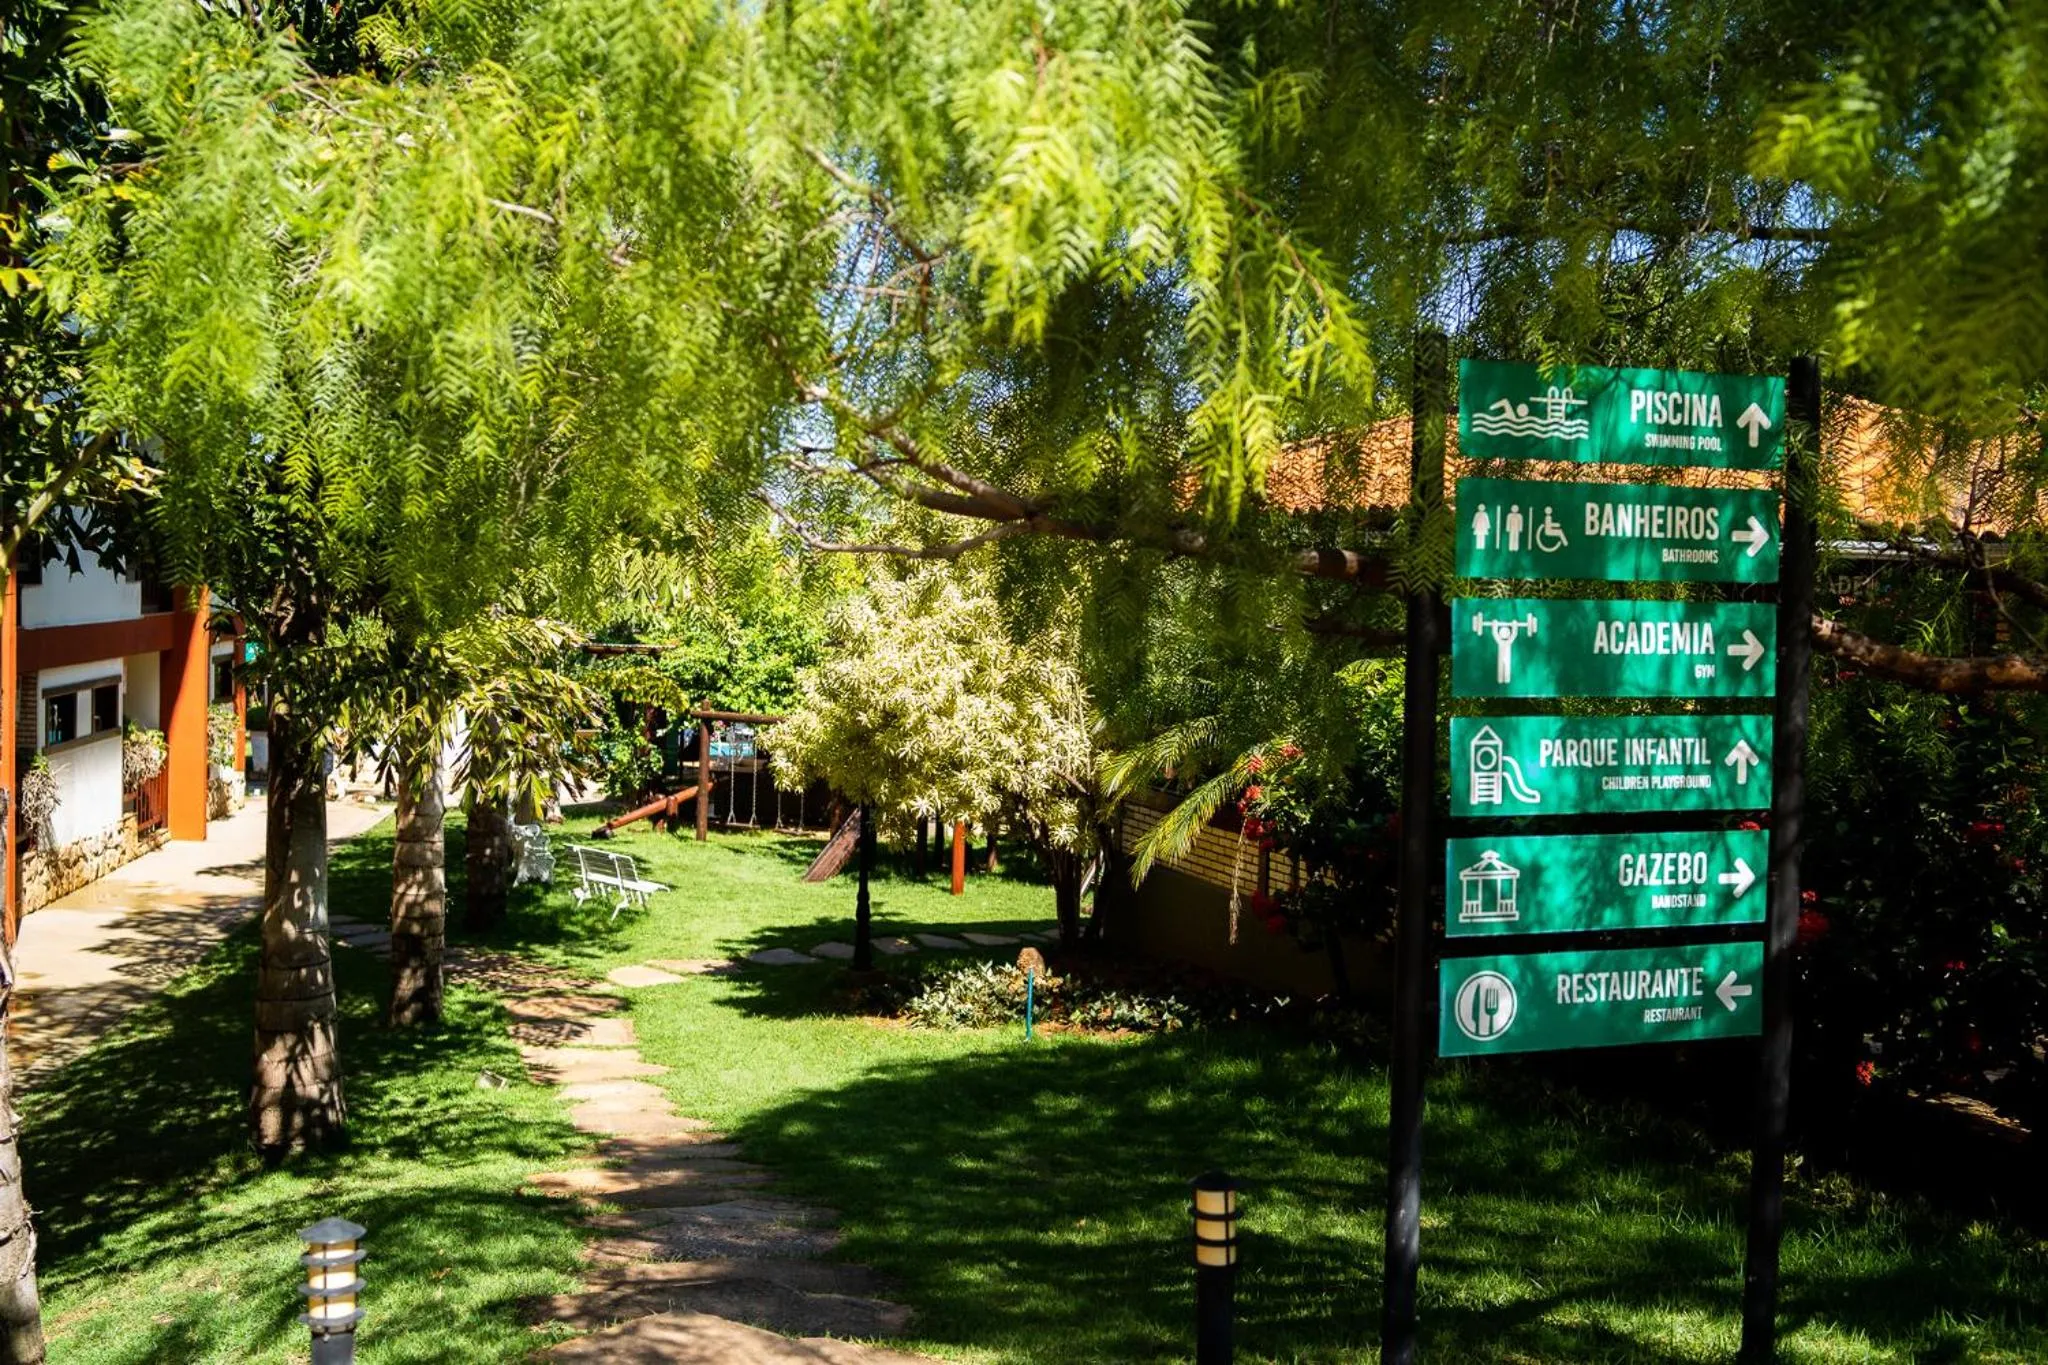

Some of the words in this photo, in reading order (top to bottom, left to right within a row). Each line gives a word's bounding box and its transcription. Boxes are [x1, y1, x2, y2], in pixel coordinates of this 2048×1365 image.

[1630, 389, 1723, 428] PISCINA
[1645, 433, 1695, 450] SWIMMING
[1697, 436, 1722, 451] POOL
[1585, 503, 1719, 541] BANHEIROS
[1662, 548, 1719, 564] BATHROOMS
[1594, 621, 1716, 656] ACADEMIA
[1695, 664, 1716, 679] GYM
[1539, 739, 1619, 768] PARQUE
[1624, 738, 1712, 768] INFANTIL
[1602, 776, 1649, 790] CHILDREN
[1651, 775, 1712, 789] PLAYGROUND
[1619, 852, 1707, 887] GAZEBO
[1557, 967, 1704, 1005] RESTAURANTE
[1644, 1006, 1703, 1024] RESTAURANT
